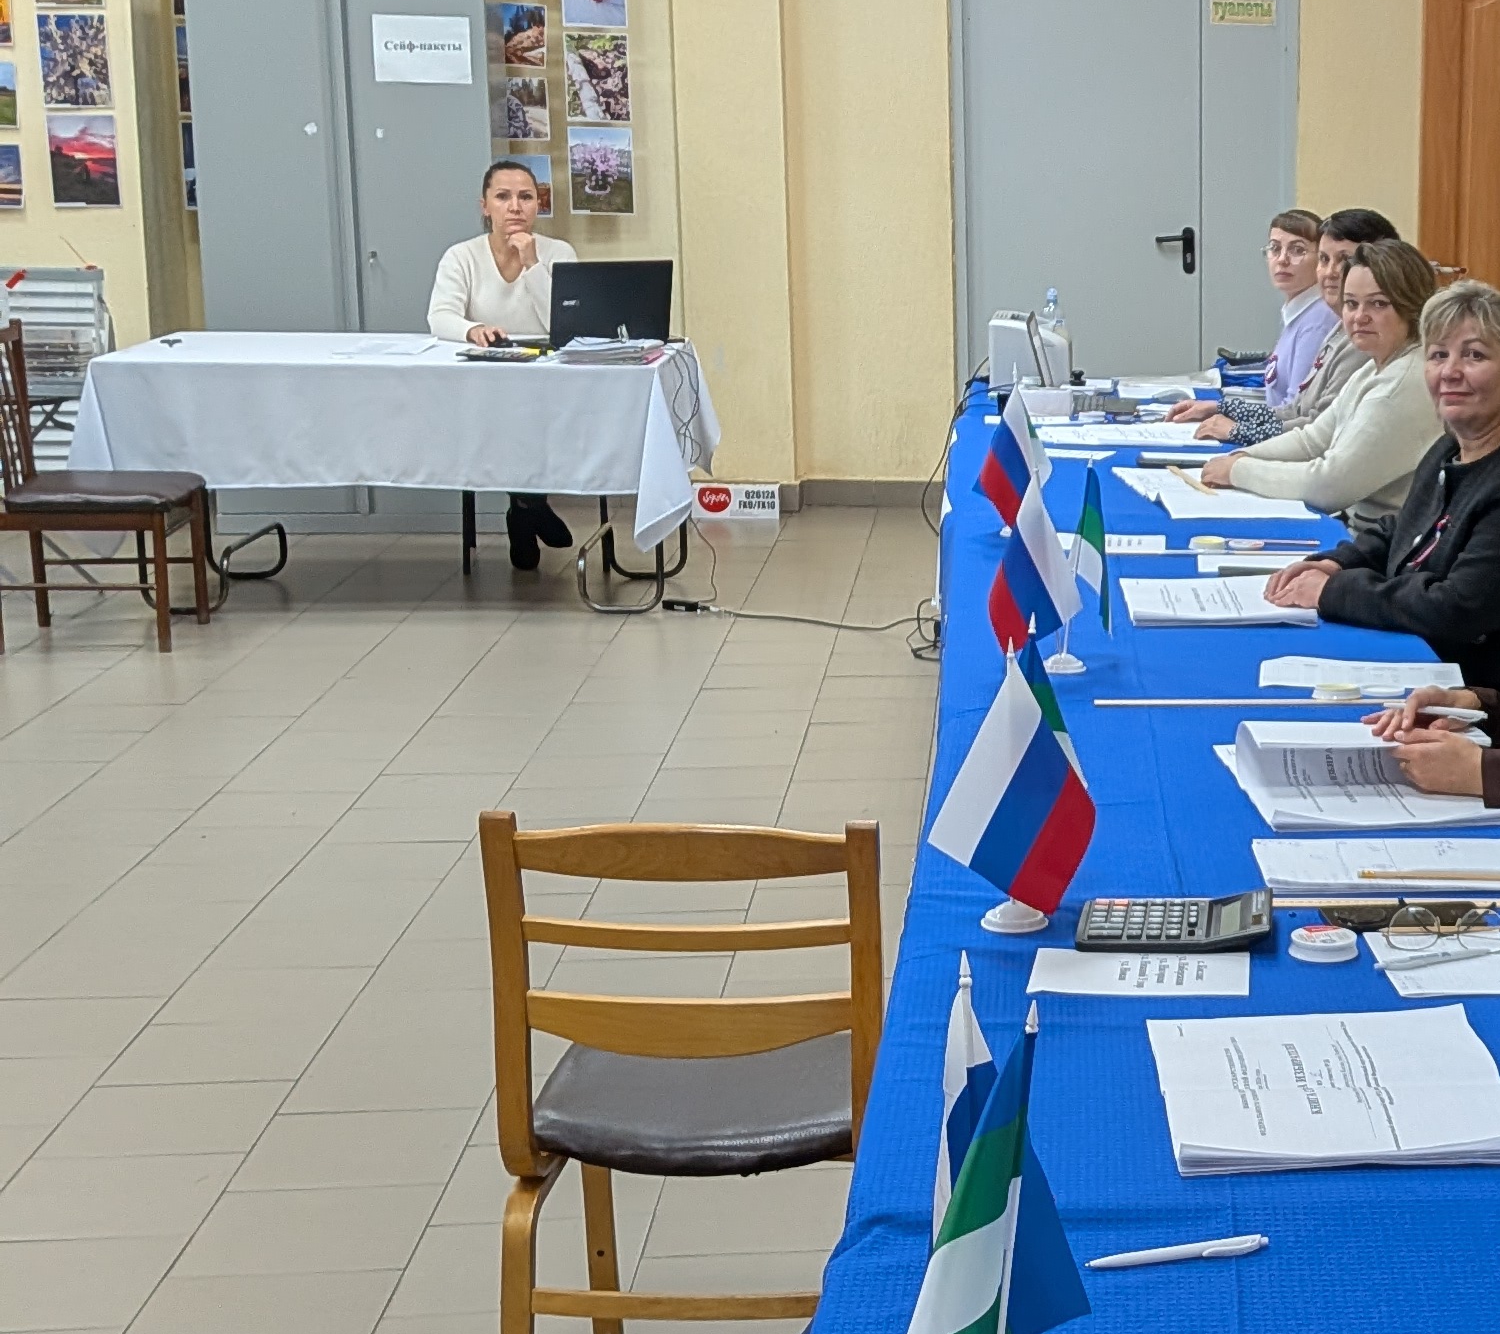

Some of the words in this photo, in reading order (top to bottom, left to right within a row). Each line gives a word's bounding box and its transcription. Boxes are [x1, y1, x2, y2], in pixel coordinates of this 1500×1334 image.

[1212, 1, 1272, 21] туалеты
[384, 41, 462, 53] Сейф-пакеты
[745, 490, 775, 499] Q2612A
[738, 500, 775, 509] FX9/FX10
